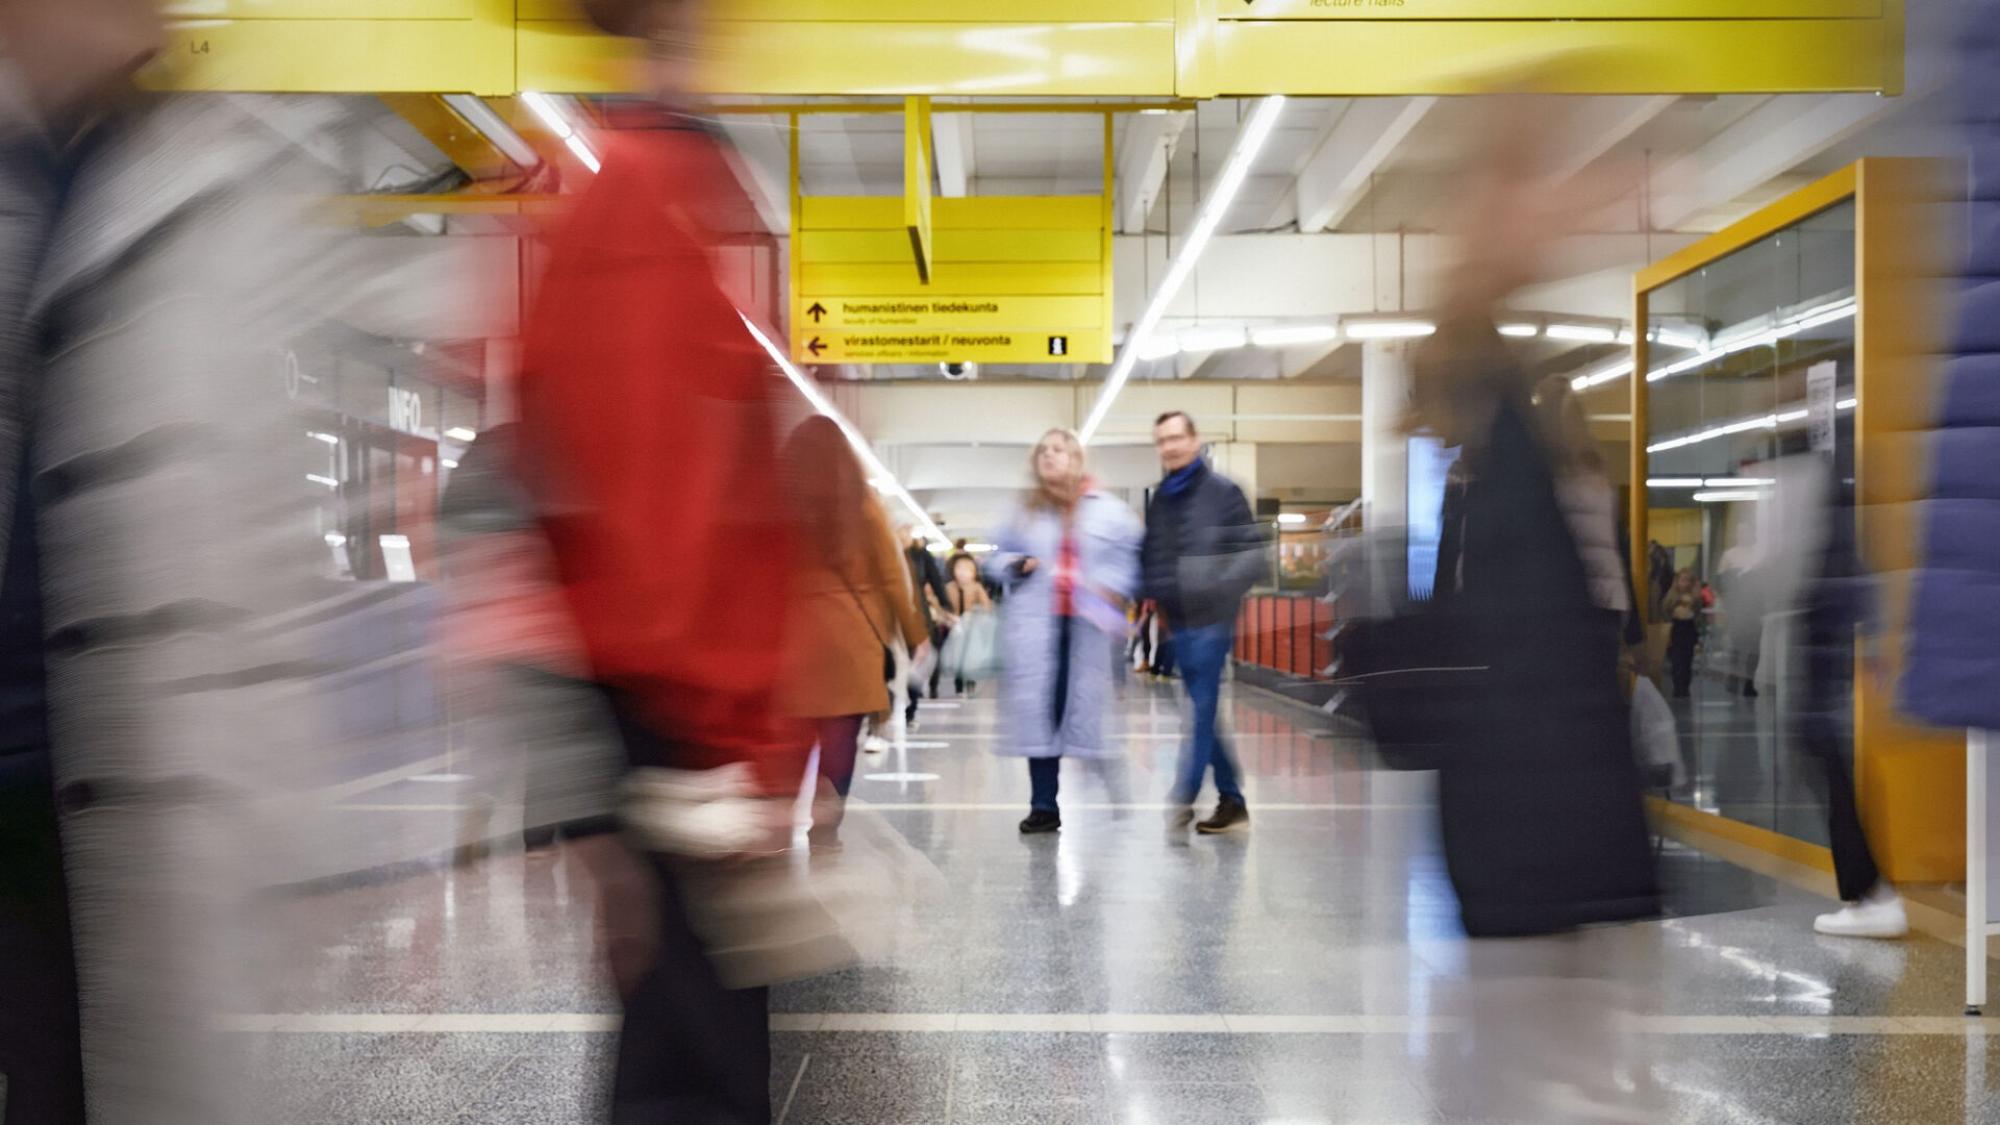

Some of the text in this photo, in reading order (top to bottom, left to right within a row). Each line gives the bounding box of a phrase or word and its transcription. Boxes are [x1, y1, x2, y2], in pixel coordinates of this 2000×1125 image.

[191, 40, 210, 54] L4
[843, 303, 998, 313] humanistinen tiedekunta
[844, 335, 940, 346] virastomestarit
[951, 336, 1011, 346] neuvonta
